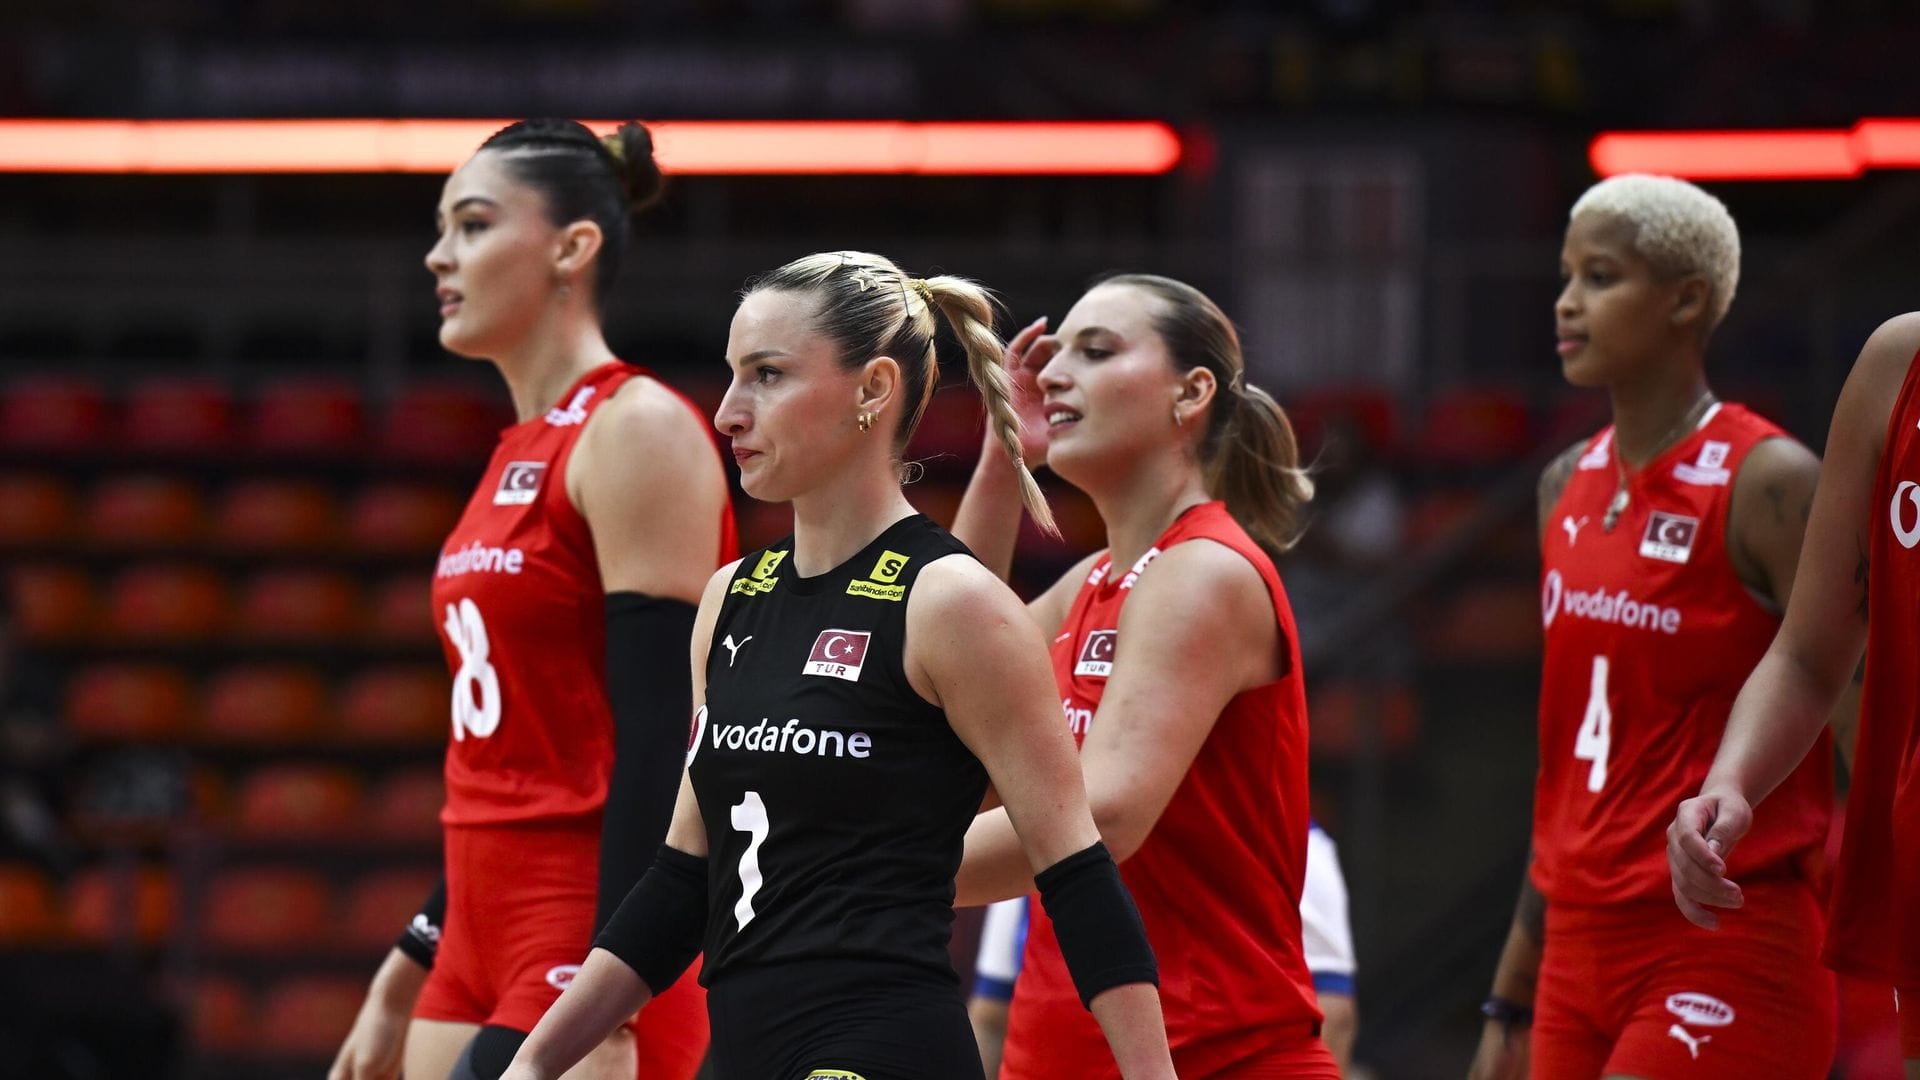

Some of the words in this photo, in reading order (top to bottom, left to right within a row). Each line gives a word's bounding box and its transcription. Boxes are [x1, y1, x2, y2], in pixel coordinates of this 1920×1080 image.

[881, 559, 902, 577] S
[1563, 587, 1681, 635] vodafone
[815, 663, 847, 676] TUR
[1084, 663, 1106, 673] TUR
[712, 717, 873, 759] vodafone
[1574, 655, 1612, 793] 4
